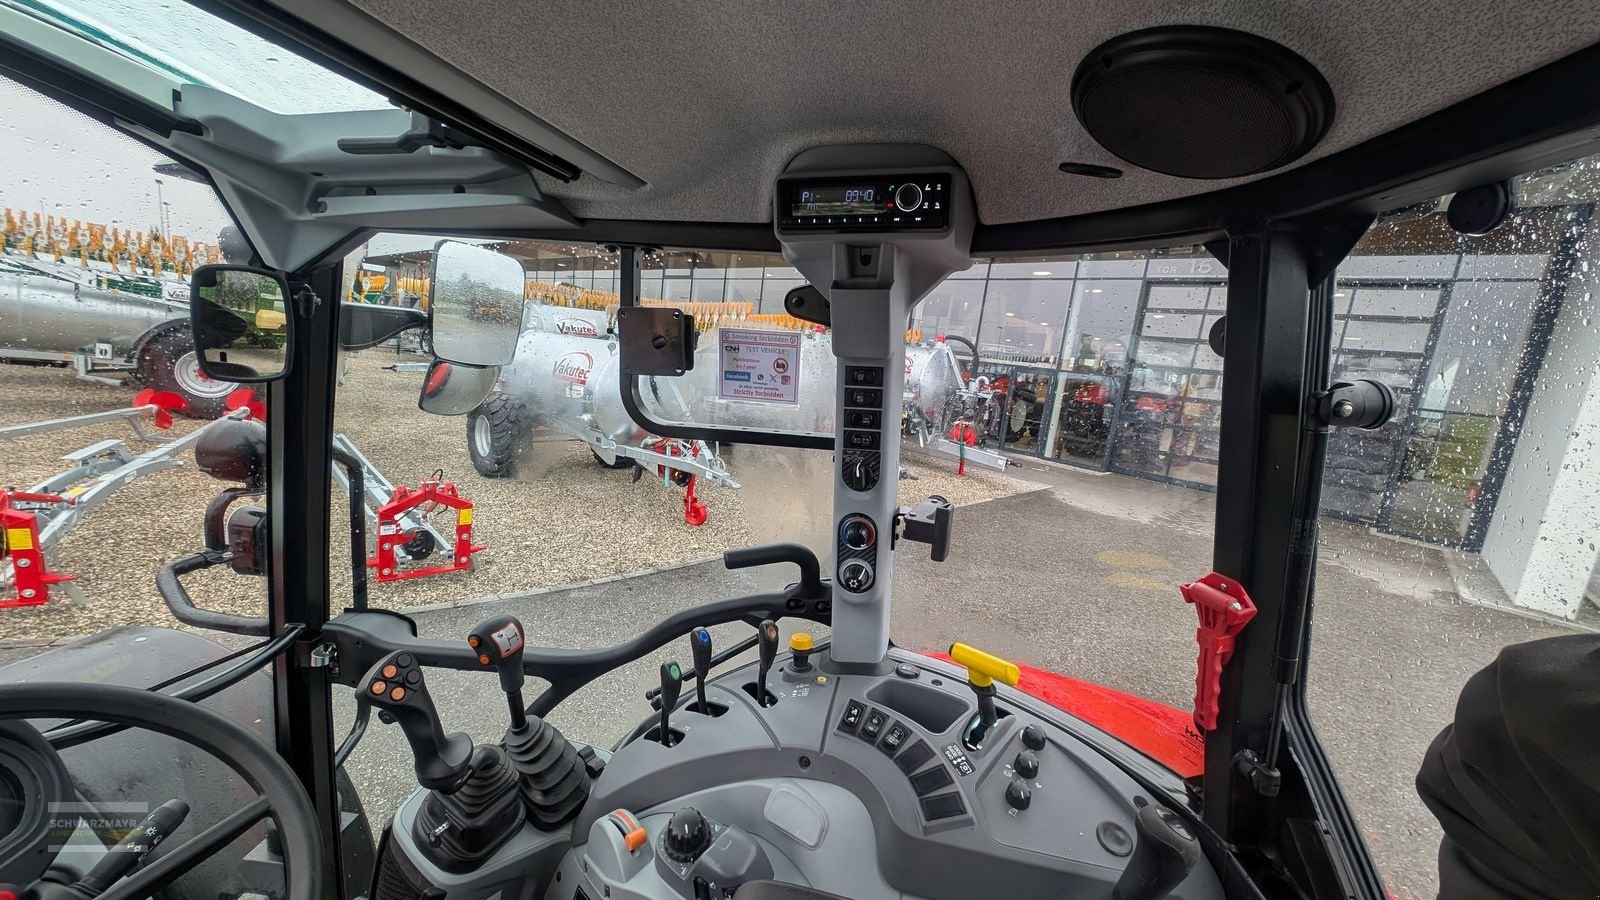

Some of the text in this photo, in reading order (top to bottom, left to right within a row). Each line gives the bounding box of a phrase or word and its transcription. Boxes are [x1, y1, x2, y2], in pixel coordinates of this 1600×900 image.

[1157, 259, 1213, 274] TOR 16
[556, 321, 598, 335] Vakutec
[731, 333, 758, 342] Smoking
[761, 347, 785, 355] VEHICLE
[552, 358, 590, 380] Vakutec
